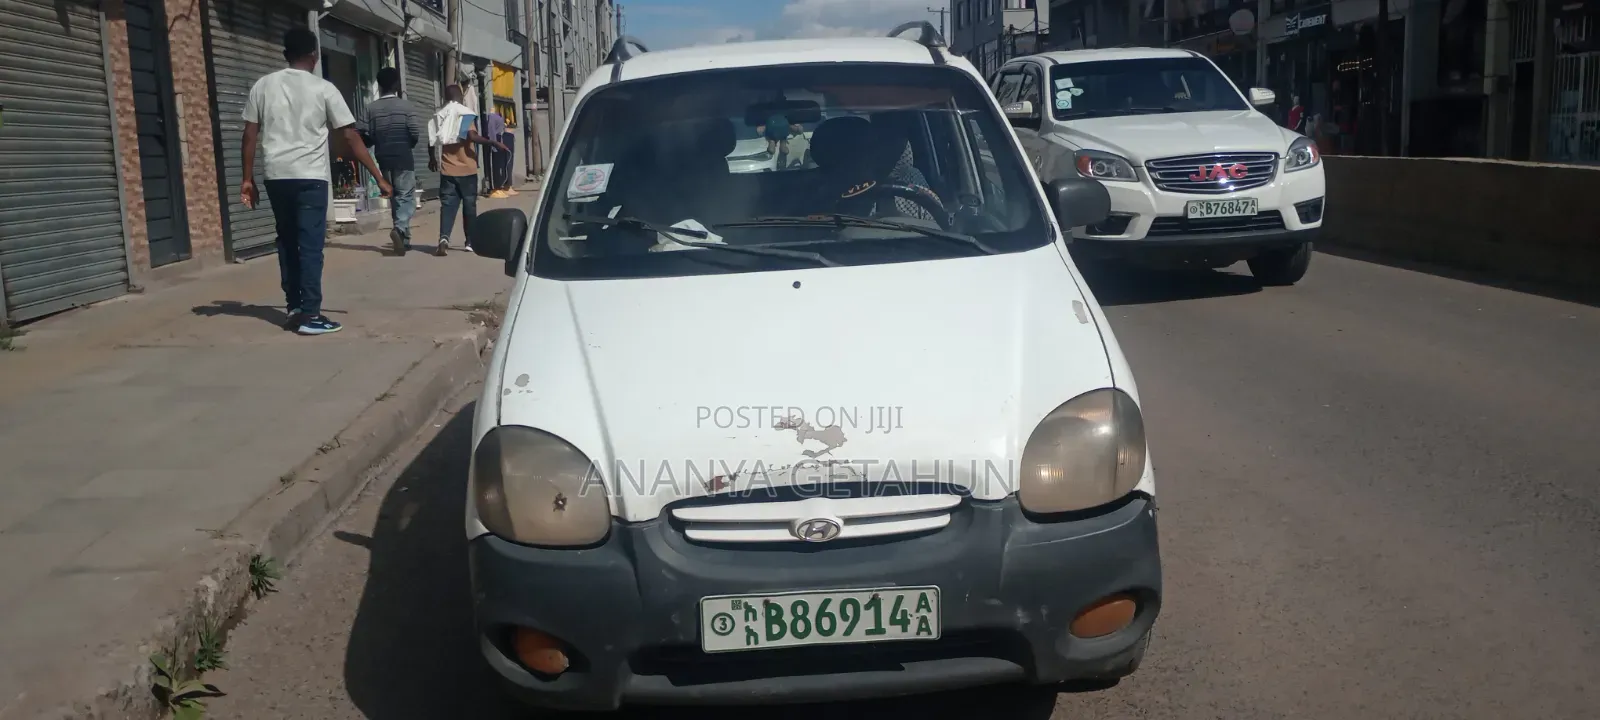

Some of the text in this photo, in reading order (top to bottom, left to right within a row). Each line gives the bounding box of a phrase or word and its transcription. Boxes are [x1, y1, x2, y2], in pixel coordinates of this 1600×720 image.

[1189, 163, 1249, 182] JAC
[1206, 201, 1249, 215] B76847
[764, 595, 911, 641] B86914
